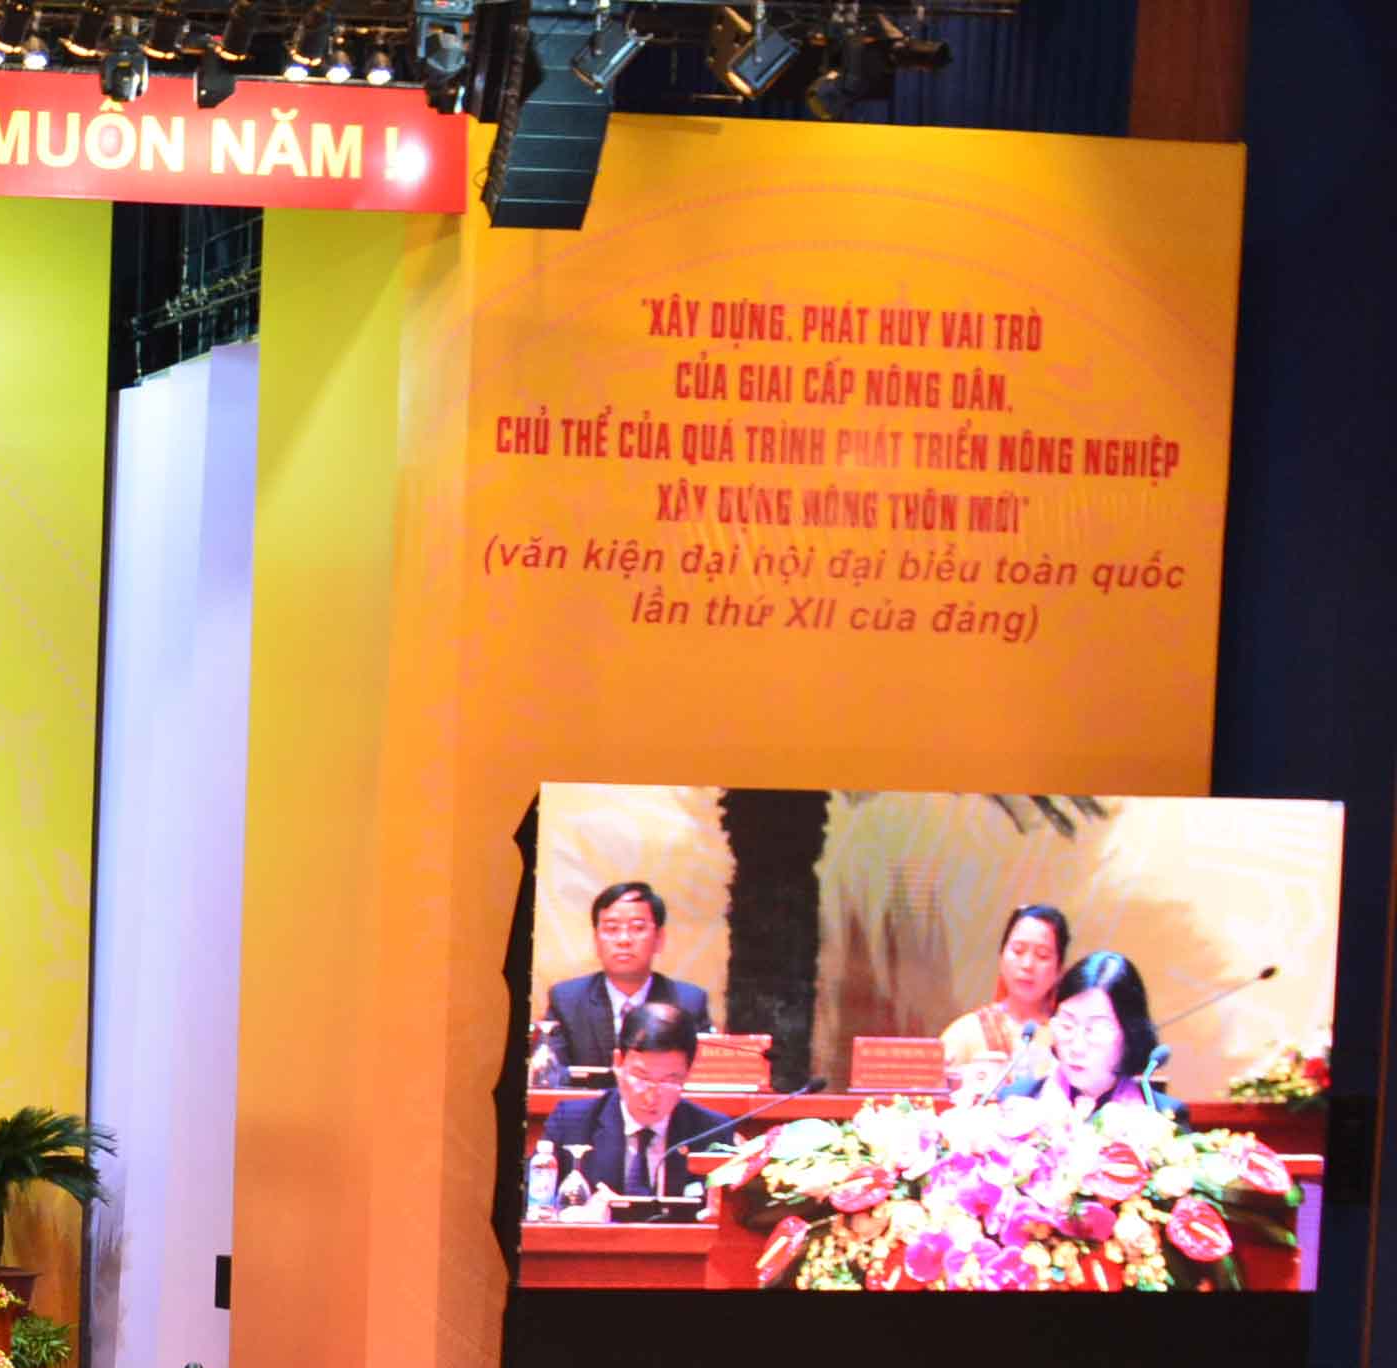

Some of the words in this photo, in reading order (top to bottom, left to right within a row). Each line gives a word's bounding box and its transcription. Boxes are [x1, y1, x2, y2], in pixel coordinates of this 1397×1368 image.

[210, 107, 362, 179] NĂM
[802, 300, 869, 344] PHÁT
[879, 307, 931, 347] HUY
[941, 311, 984, 350] VAI
[994, 306, 1043, 351] TRÒ
[676, 352, 728, 400] CỦA
[739, 364, 793, 404] GIAI
[804, 357, 855, 405] CẤP
[865, 363, 941, 409] NÔNG
[496, 405, 550, 456] CHỦ
[561, 405, 612, 457] THỂ
[619, 410, 671, 459] CỦA
[683, 418, 733, 466] QUÁ
[746, 418, 825, 466] TRÌNH
[837, 424, 903, 468] PHÁT
[914, 419, 988, 471] TRIỂN
[998, 430, 1073, 475] NÔNG
[1085, 434, 1180, 487] NGHIỆP
[657, 477, 707, 521] XÂY
[803, 485, 877, 528] NÔNG
[889, 488, 956, 531] THÔN
[484, 535, 567, 574] (văn
[583, 538, 664, 579] kiện
[680, 544, 740, 582] đại
[828, 549, 886, 588] đại
[996, 553, 1077, 585] toàn
[1093, 551, 1186, 595] quốc
[705, 595, 774, 629] thứ
[785, 597, 837, 630] XII
[850, 600, 917, 632] của
[932, 601, 1040, 643] đảng)
